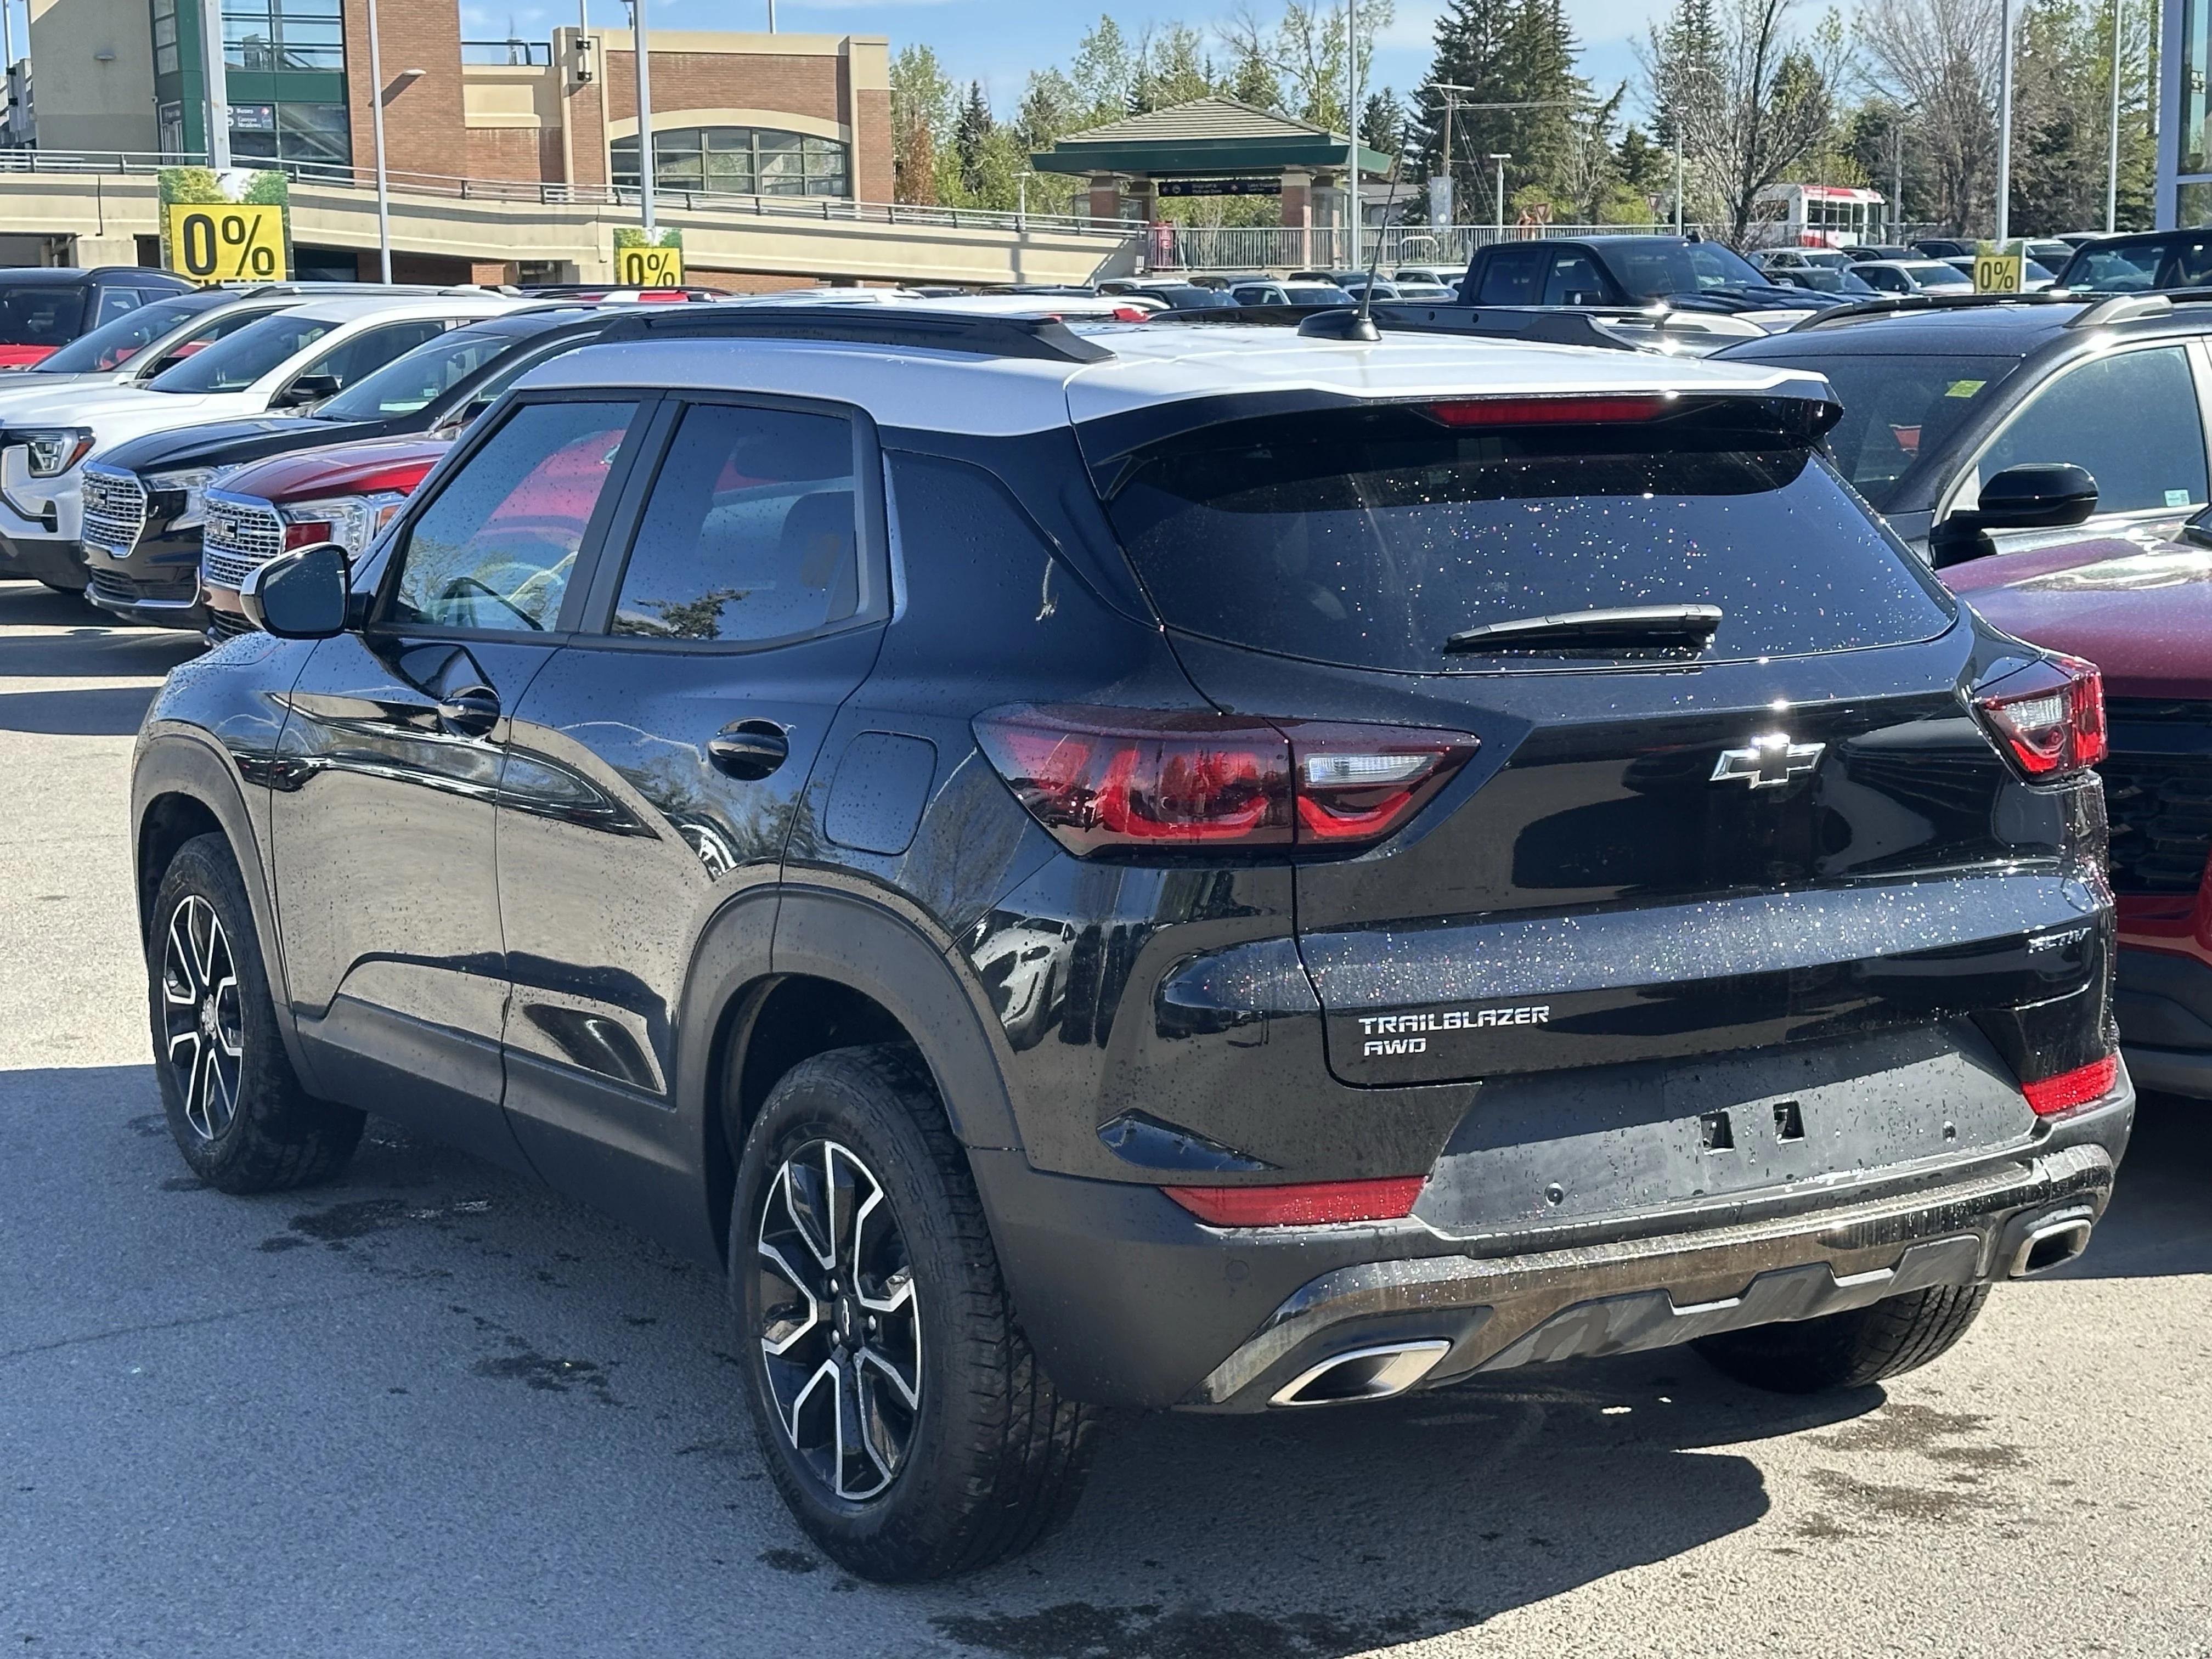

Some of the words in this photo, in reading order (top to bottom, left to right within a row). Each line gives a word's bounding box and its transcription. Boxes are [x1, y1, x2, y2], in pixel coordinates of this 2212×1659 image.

[183, 213, 275, 276] 0%
[627, 253, 675, 286] 0%
[1980, 261, 2013, 290] 0%
[1358, 1005, 1550, 1035] TRAILBLAZER
[1364, 1037, 1426, 1056] AWD
